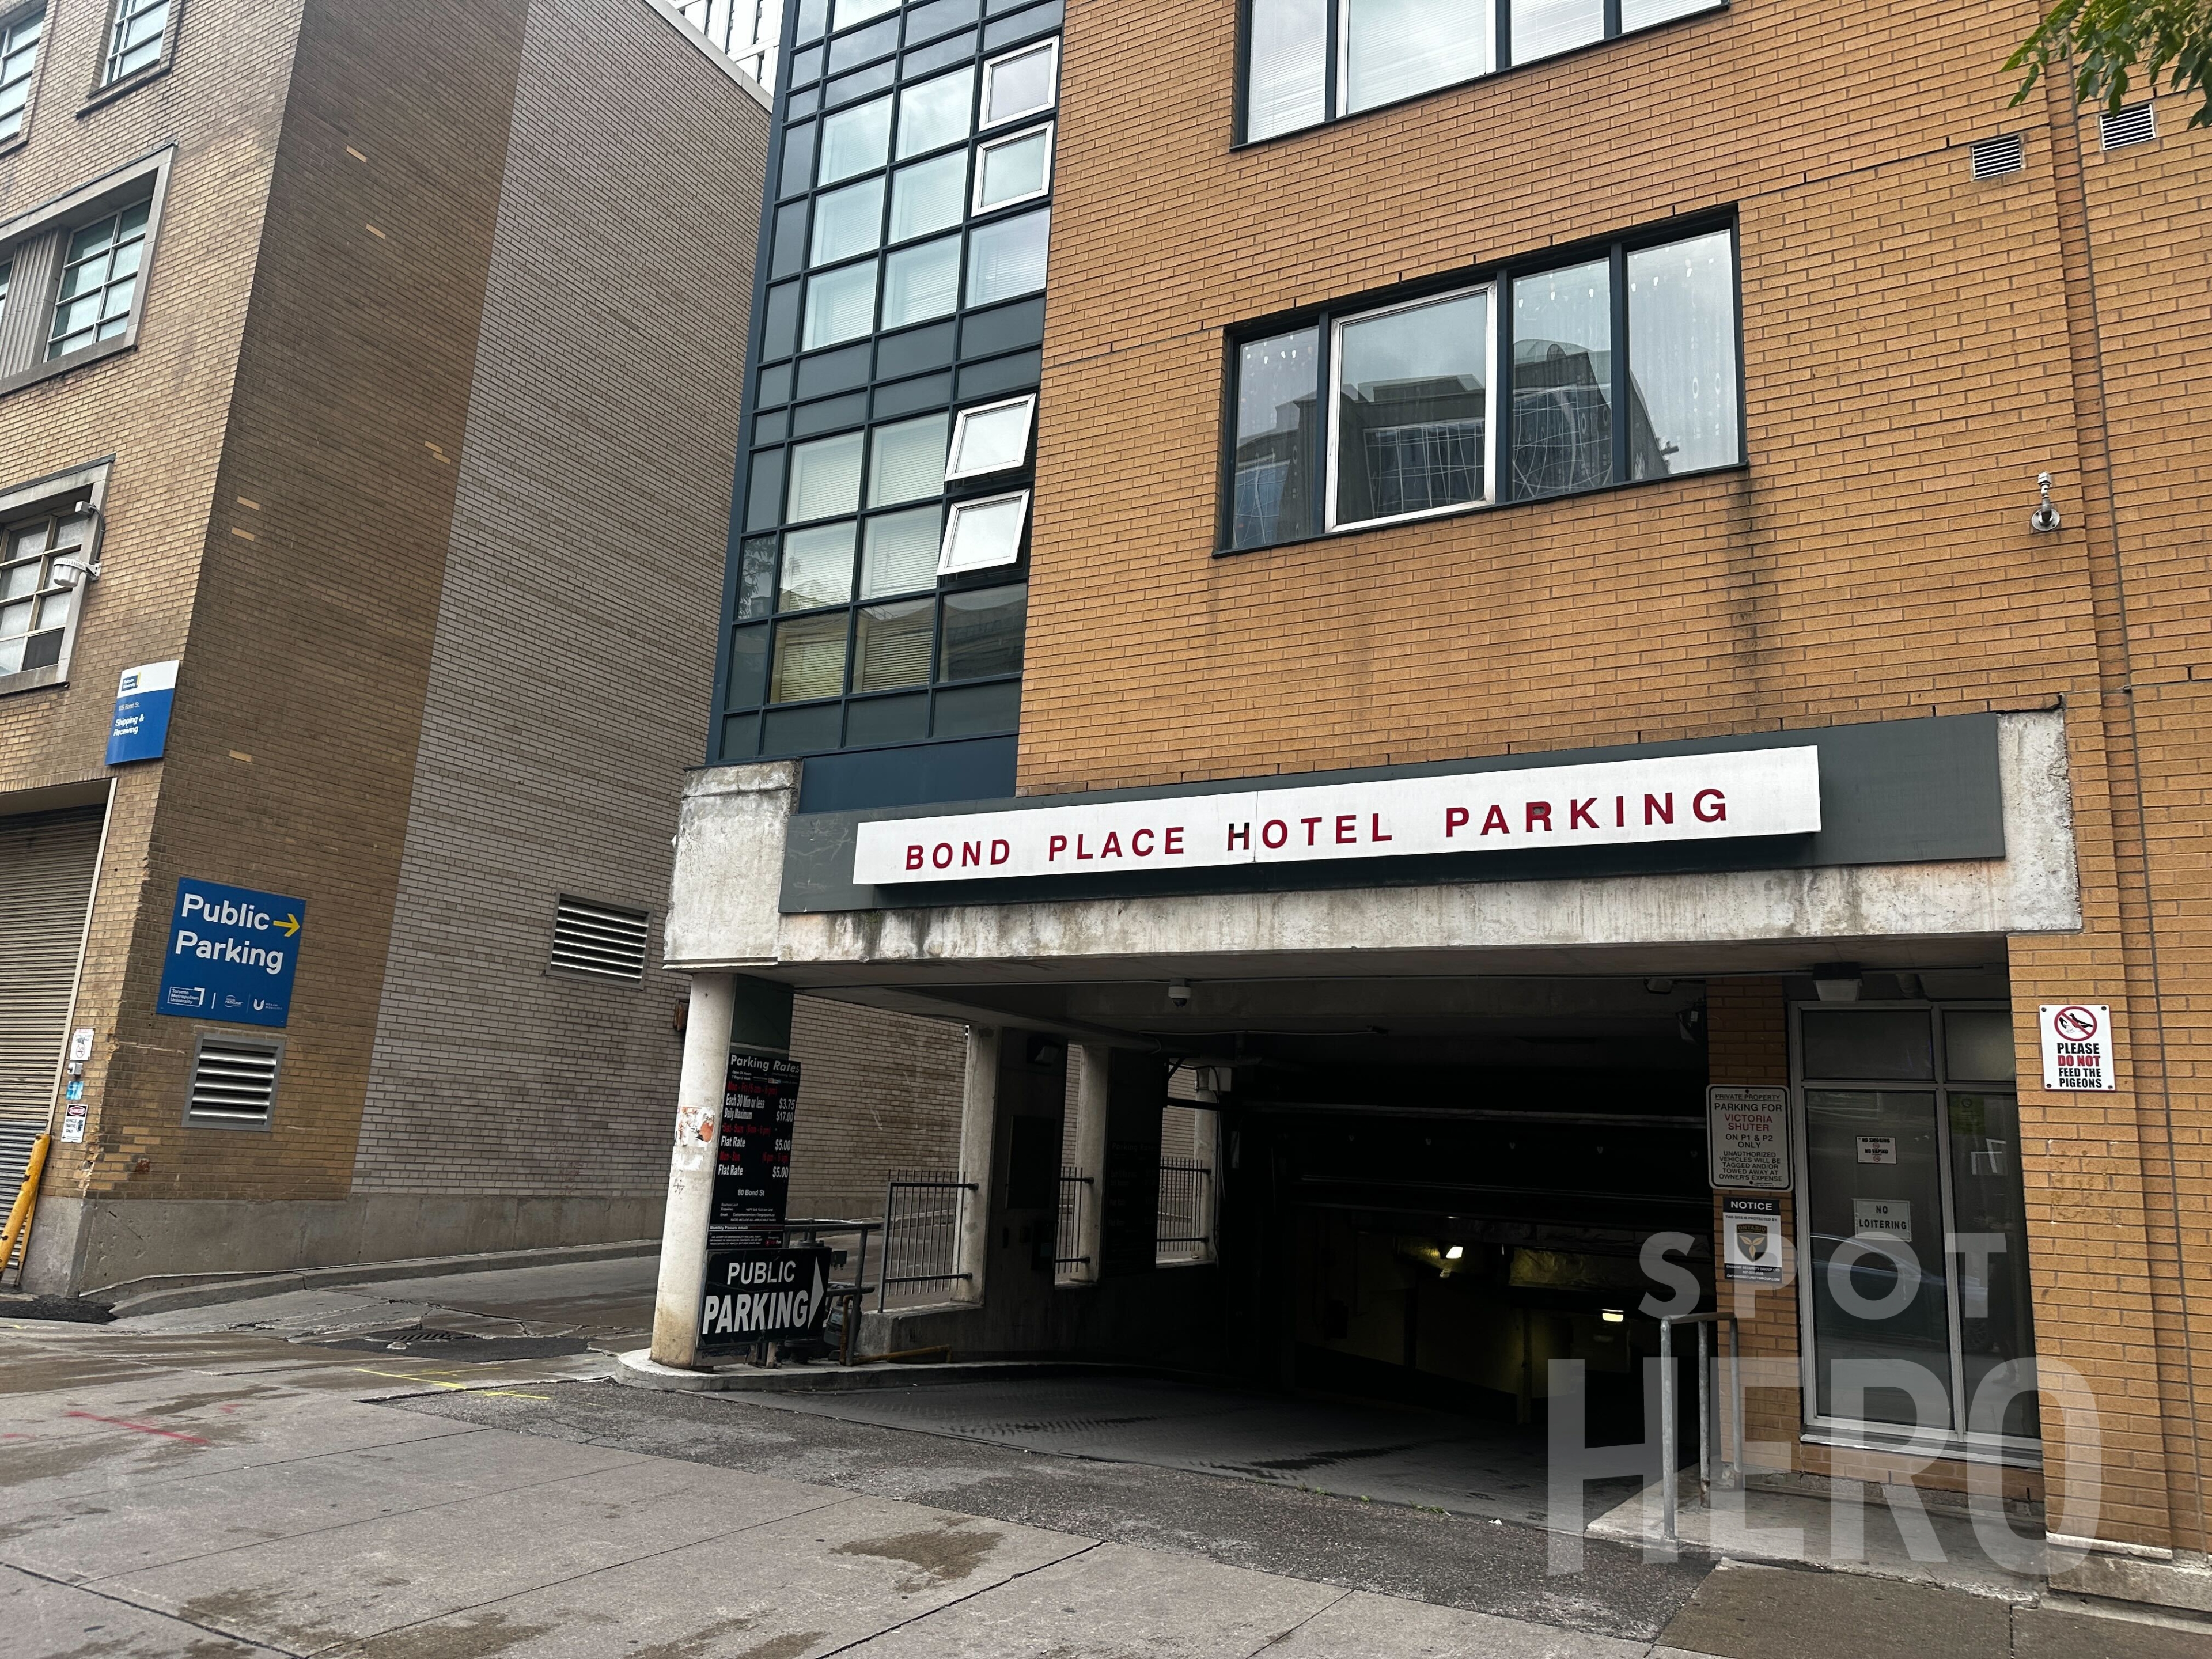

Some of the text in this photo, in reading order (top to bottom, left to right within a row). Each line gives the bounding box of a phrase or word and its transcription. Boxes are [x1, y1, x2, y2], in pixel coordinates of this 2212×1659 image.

[115, 714, 145, 728] Shipping &
[113, 725, 139, 737] Receiving
[906, 789, 1727, 870] BOND PLACE HOTEL PARKING
[181, 893, 270, 930] Public
[175, 930, 283, 975] Parking
[2057, 1043, 2099, 1054] PLEASE
[730, 1054, 800, 1073] Parking Rates
[2058, 1055, 2100, 1067] DO NOT
[2058, 1067, 2101, 1077] FEED THE
[2059, 1078, 2102, 1088] PIGEONS
[726, 1093, 796, 1110] Each 30 Min or less $3.75
[1714, 1103, 1782, 1112] PARKING FOR
[724, 1107, 734, 1121] Daily
[776, 1111, 794, 1122] $17.00
[1724, 1113, 1772, 1123] VICTORIA
[1728, 1123, 1769, 1131] SHUTER
[721, 1135, 791, 1152] Flat Rate $5.00
[718, 1164, 789, 1179] Flat Rate $5.00
[1730, 1200, 1773, 1210] NOTICE
[1876, 1205, 1888, 1214] NO
[1859, 1219, 1907, 1230] LOITERING
[727, 1260, 796, 1285] PUBLIC
[702, 1290, 809, 1335] PARKING
